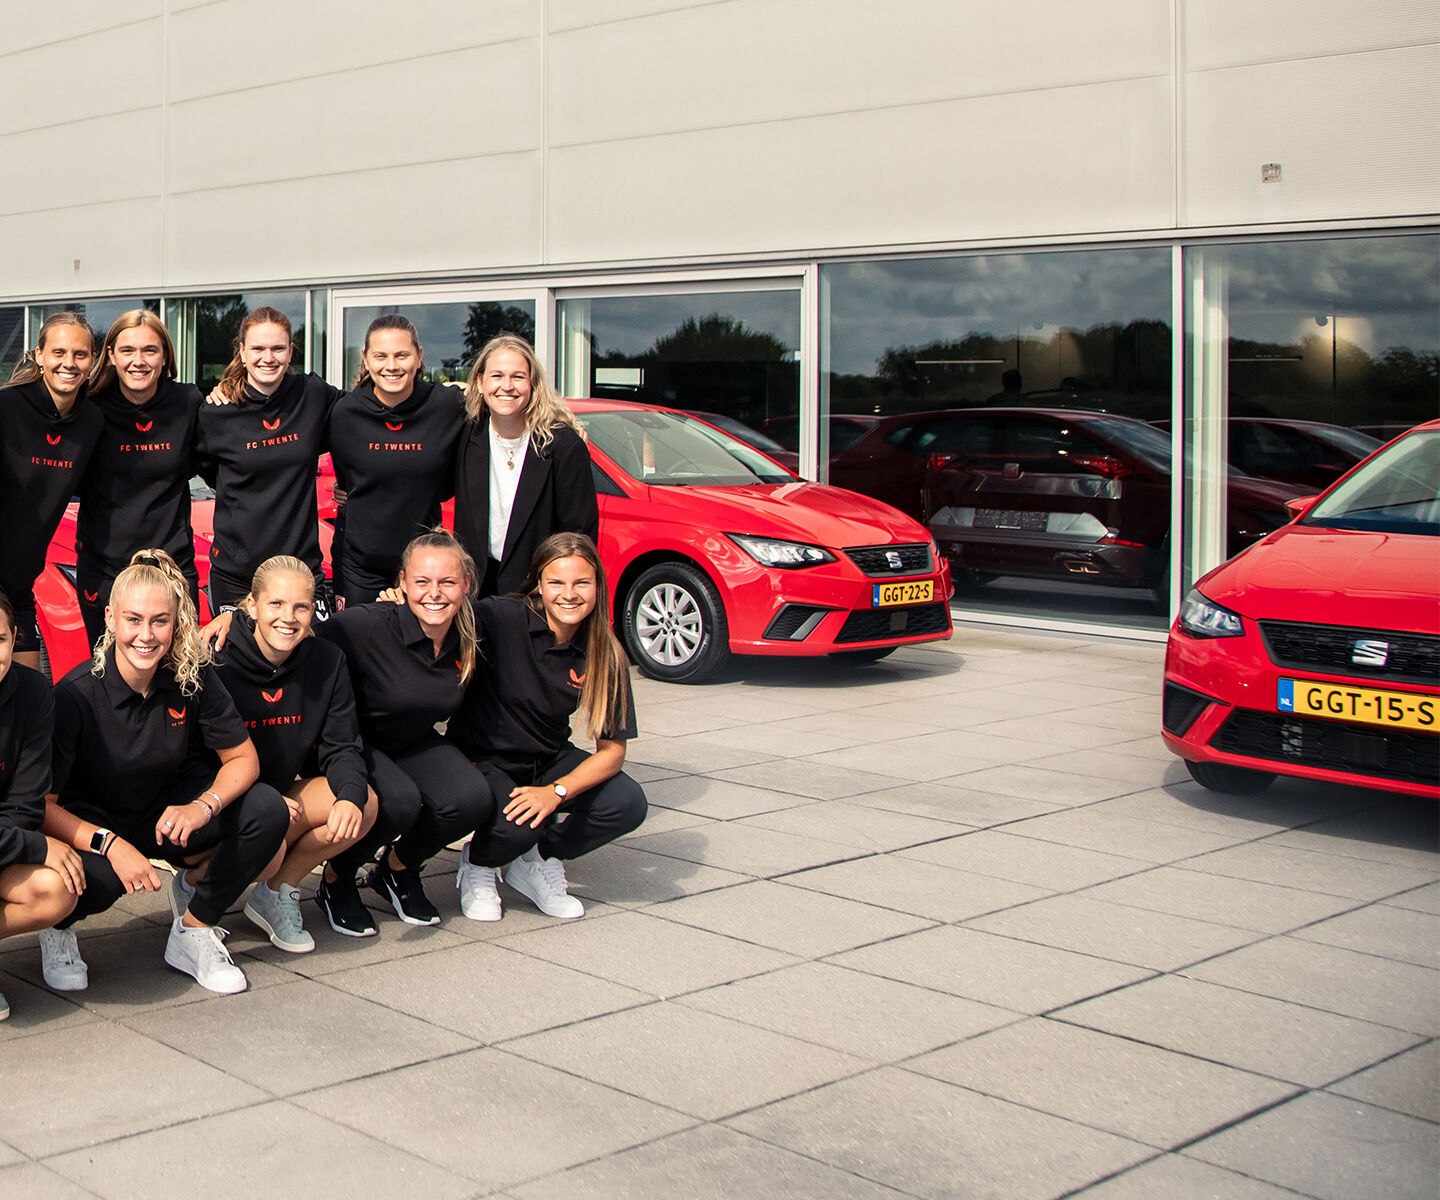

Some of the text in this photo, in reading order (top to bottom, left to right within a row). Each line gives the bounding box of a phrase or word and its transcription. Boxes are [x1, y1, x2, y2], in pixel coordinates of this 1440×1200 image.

[135, 442, 171, 451] TWENTE
[246, 433, 299, 450] FC TWENTE
[369, 442, 423, 451] FC TWENTE
[31, 456, 73, 469] FC TWENTE
[883, 583, 930, 603] GGT-22-S
[1280, 696, 1292, 706] NL
[1307, 687, 1435, 726] GGT-15-S
